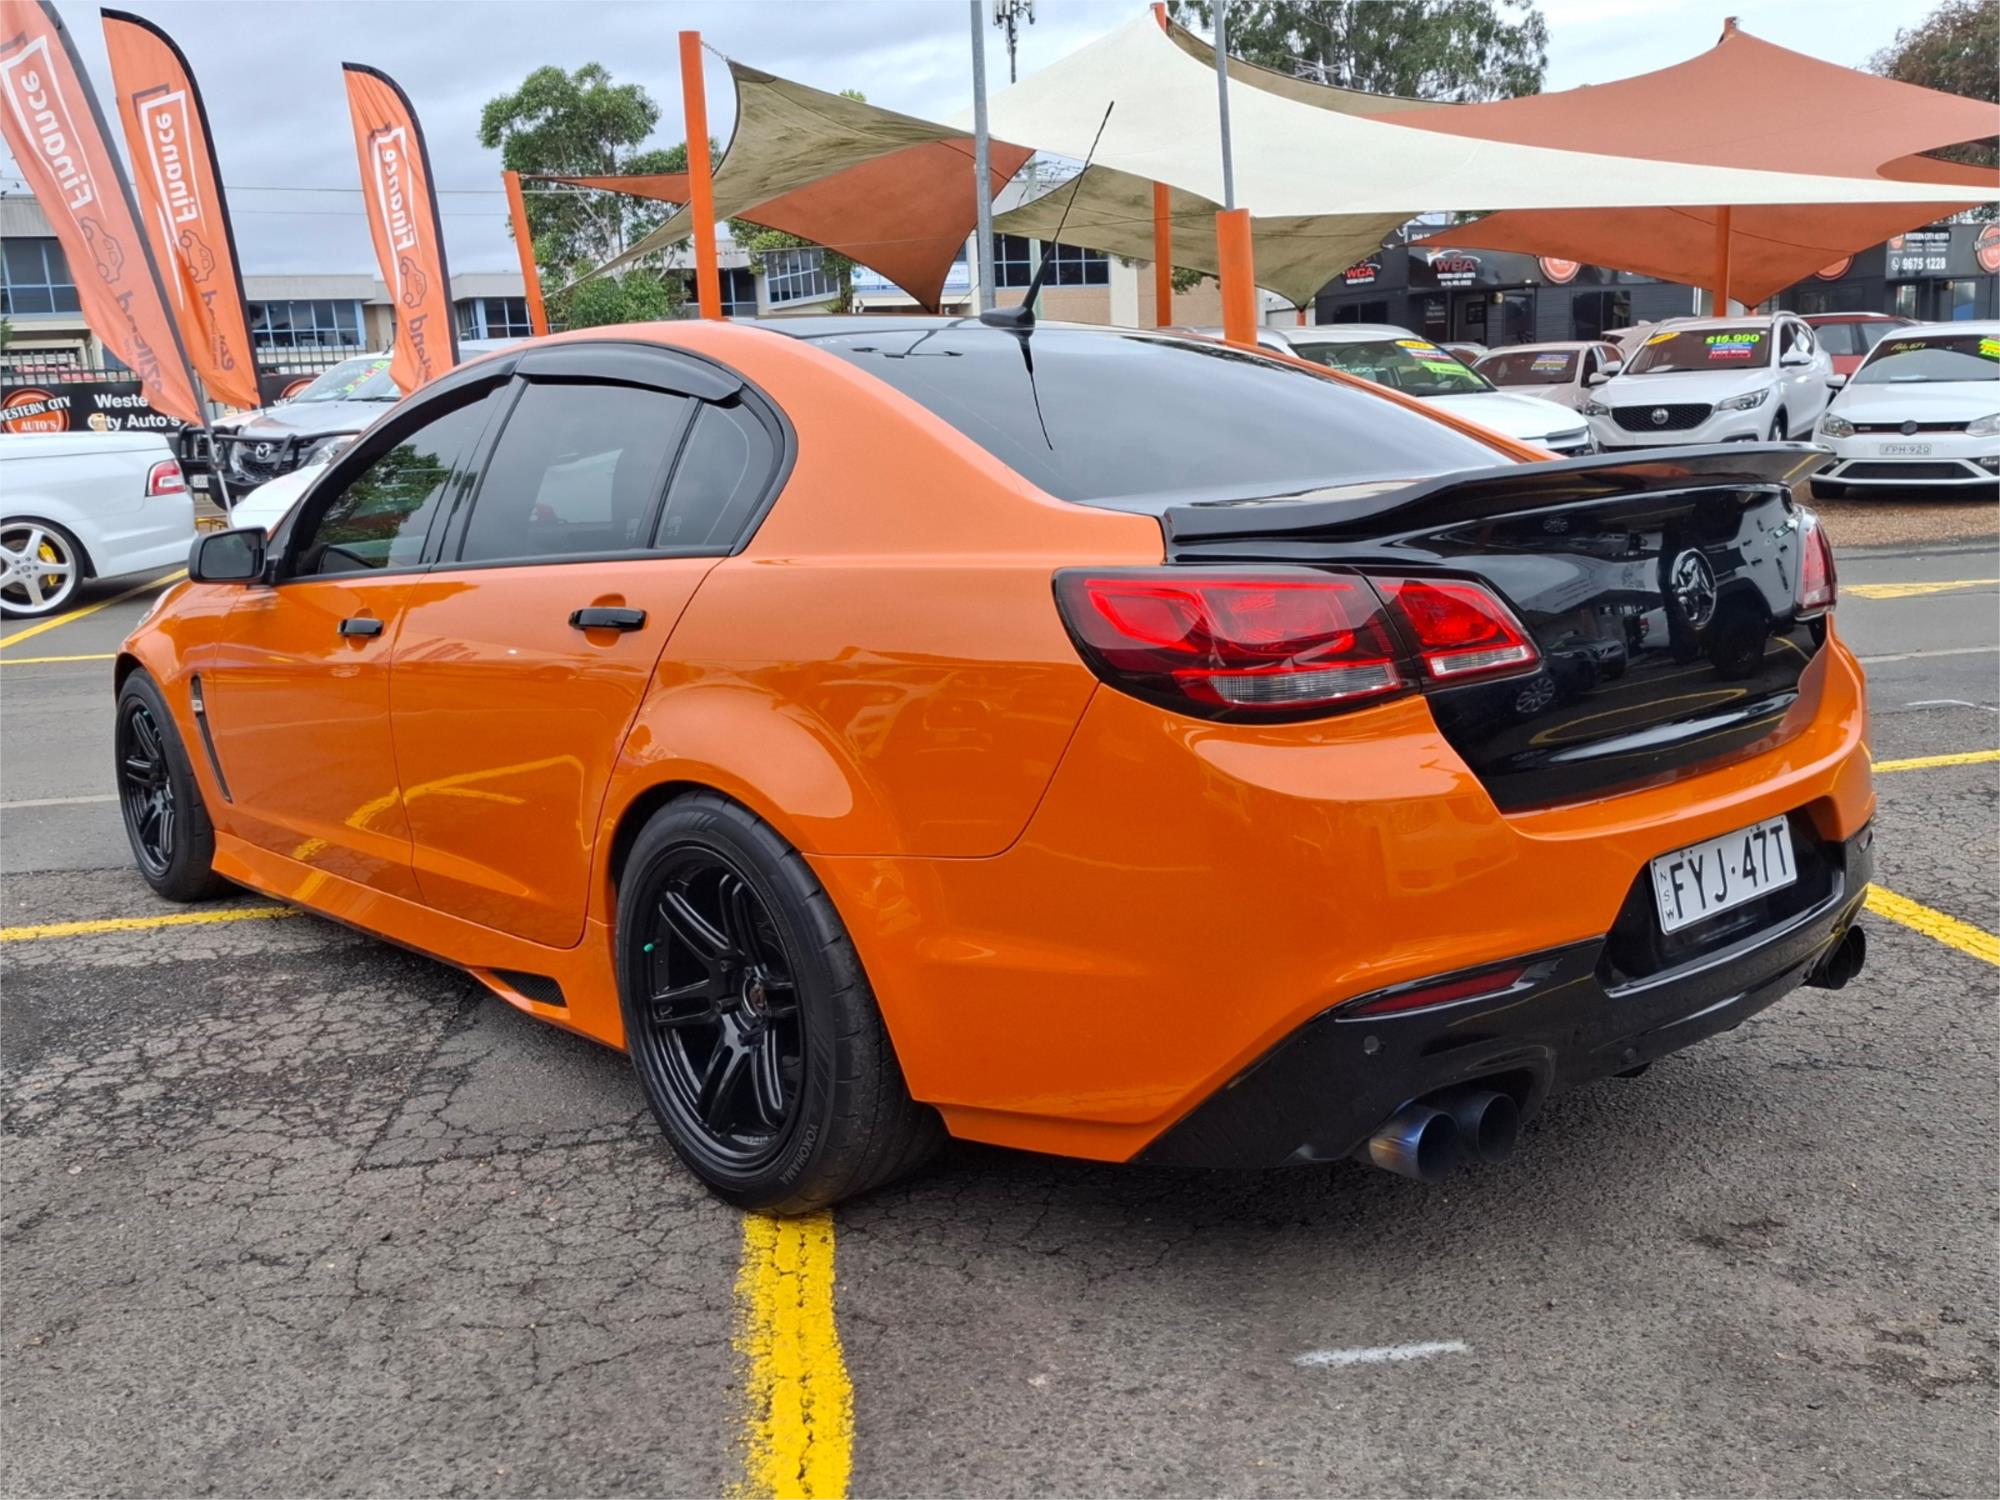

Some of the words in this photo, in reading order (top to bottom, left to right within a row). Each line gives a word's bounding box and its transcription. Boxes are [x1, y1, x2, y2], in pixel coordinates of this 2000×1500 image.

[1902, 257, 1924, 270] 9675
[48, 396, 71, 410] CITY
[20, 420, 58, 431] AUTO'S
[127, 413, 181, 428] Auto's
[779, 1123, 819, 1185] YOKOHAMA
